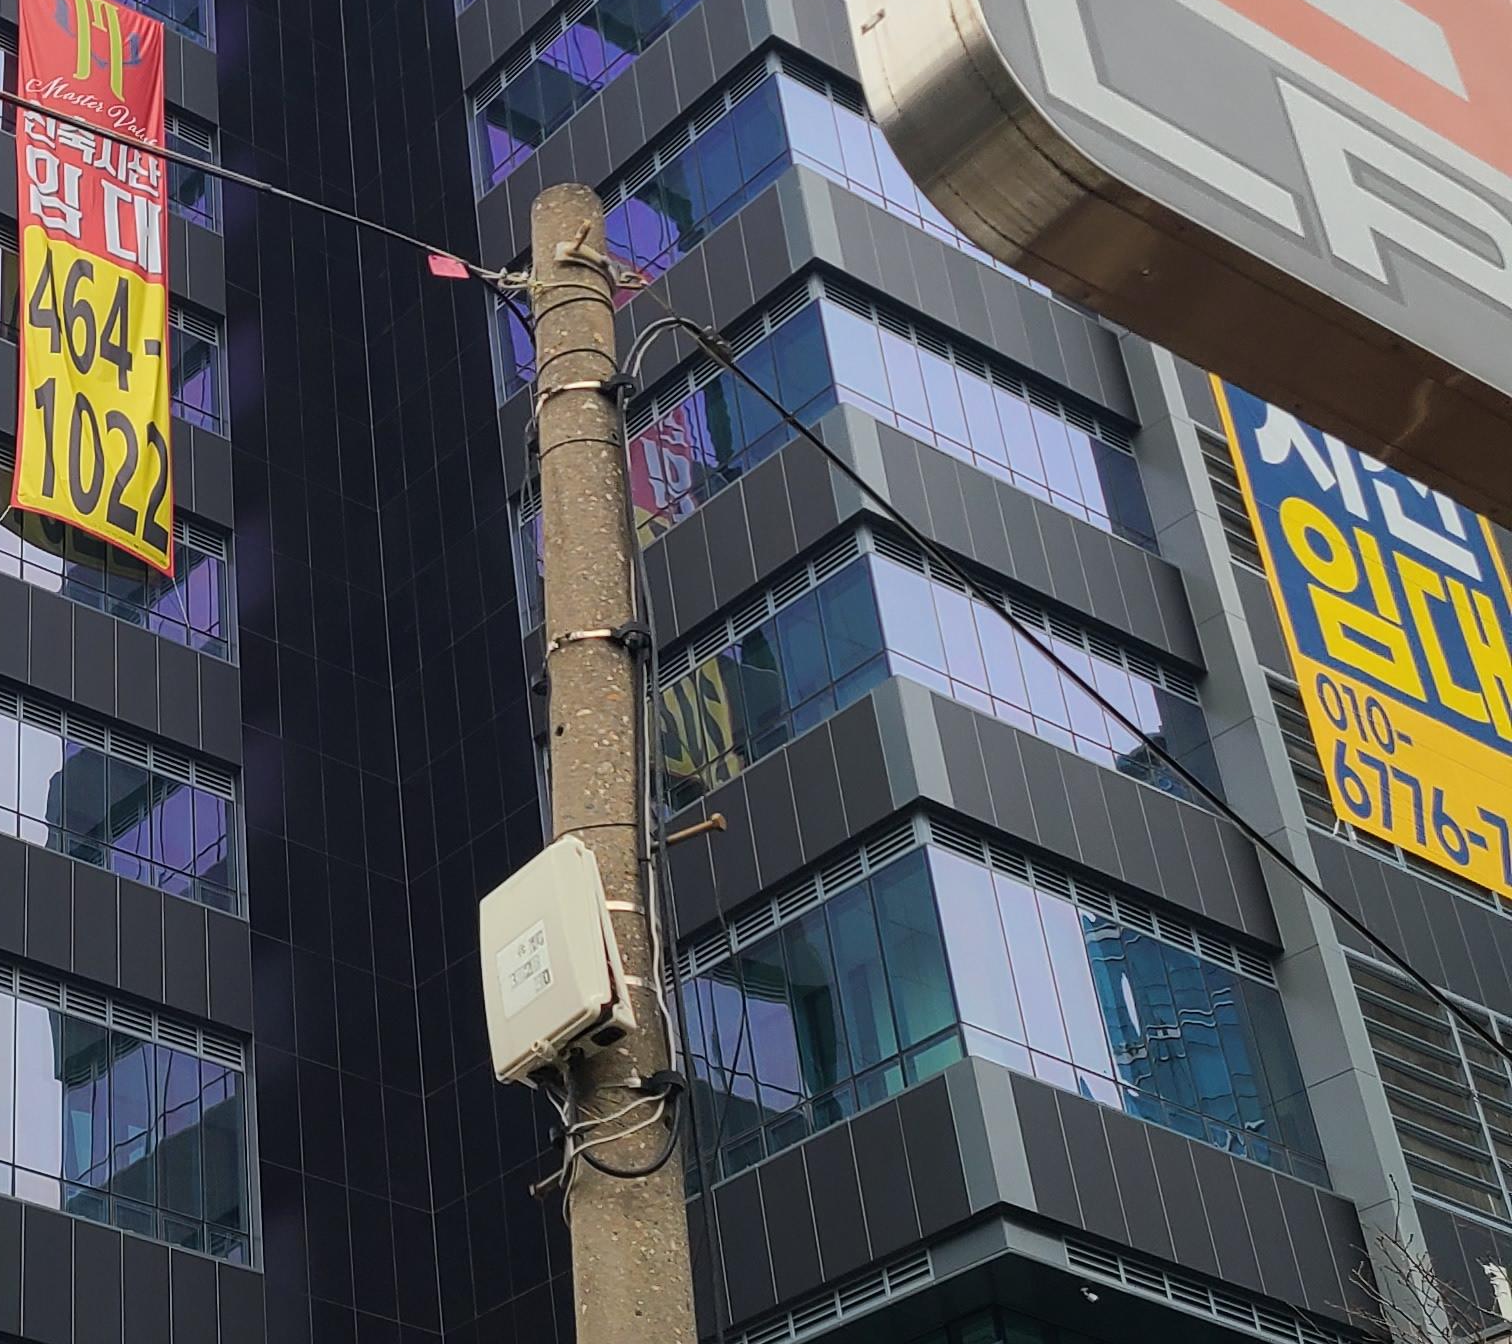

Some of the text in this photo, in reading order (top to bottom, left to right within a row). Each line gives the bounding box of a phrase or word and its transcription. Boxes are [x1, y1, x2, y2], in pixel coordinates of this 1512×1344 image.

[25, 76, 159, 147] Master Value
[25, 144, 162, 275] 임대
[28, 248, 162, 393] 464-
[33, 376, 170, 552] 1022
[1279, 496, 1512, 743] 임대
[1315, 672, 1414, 756] 010-
